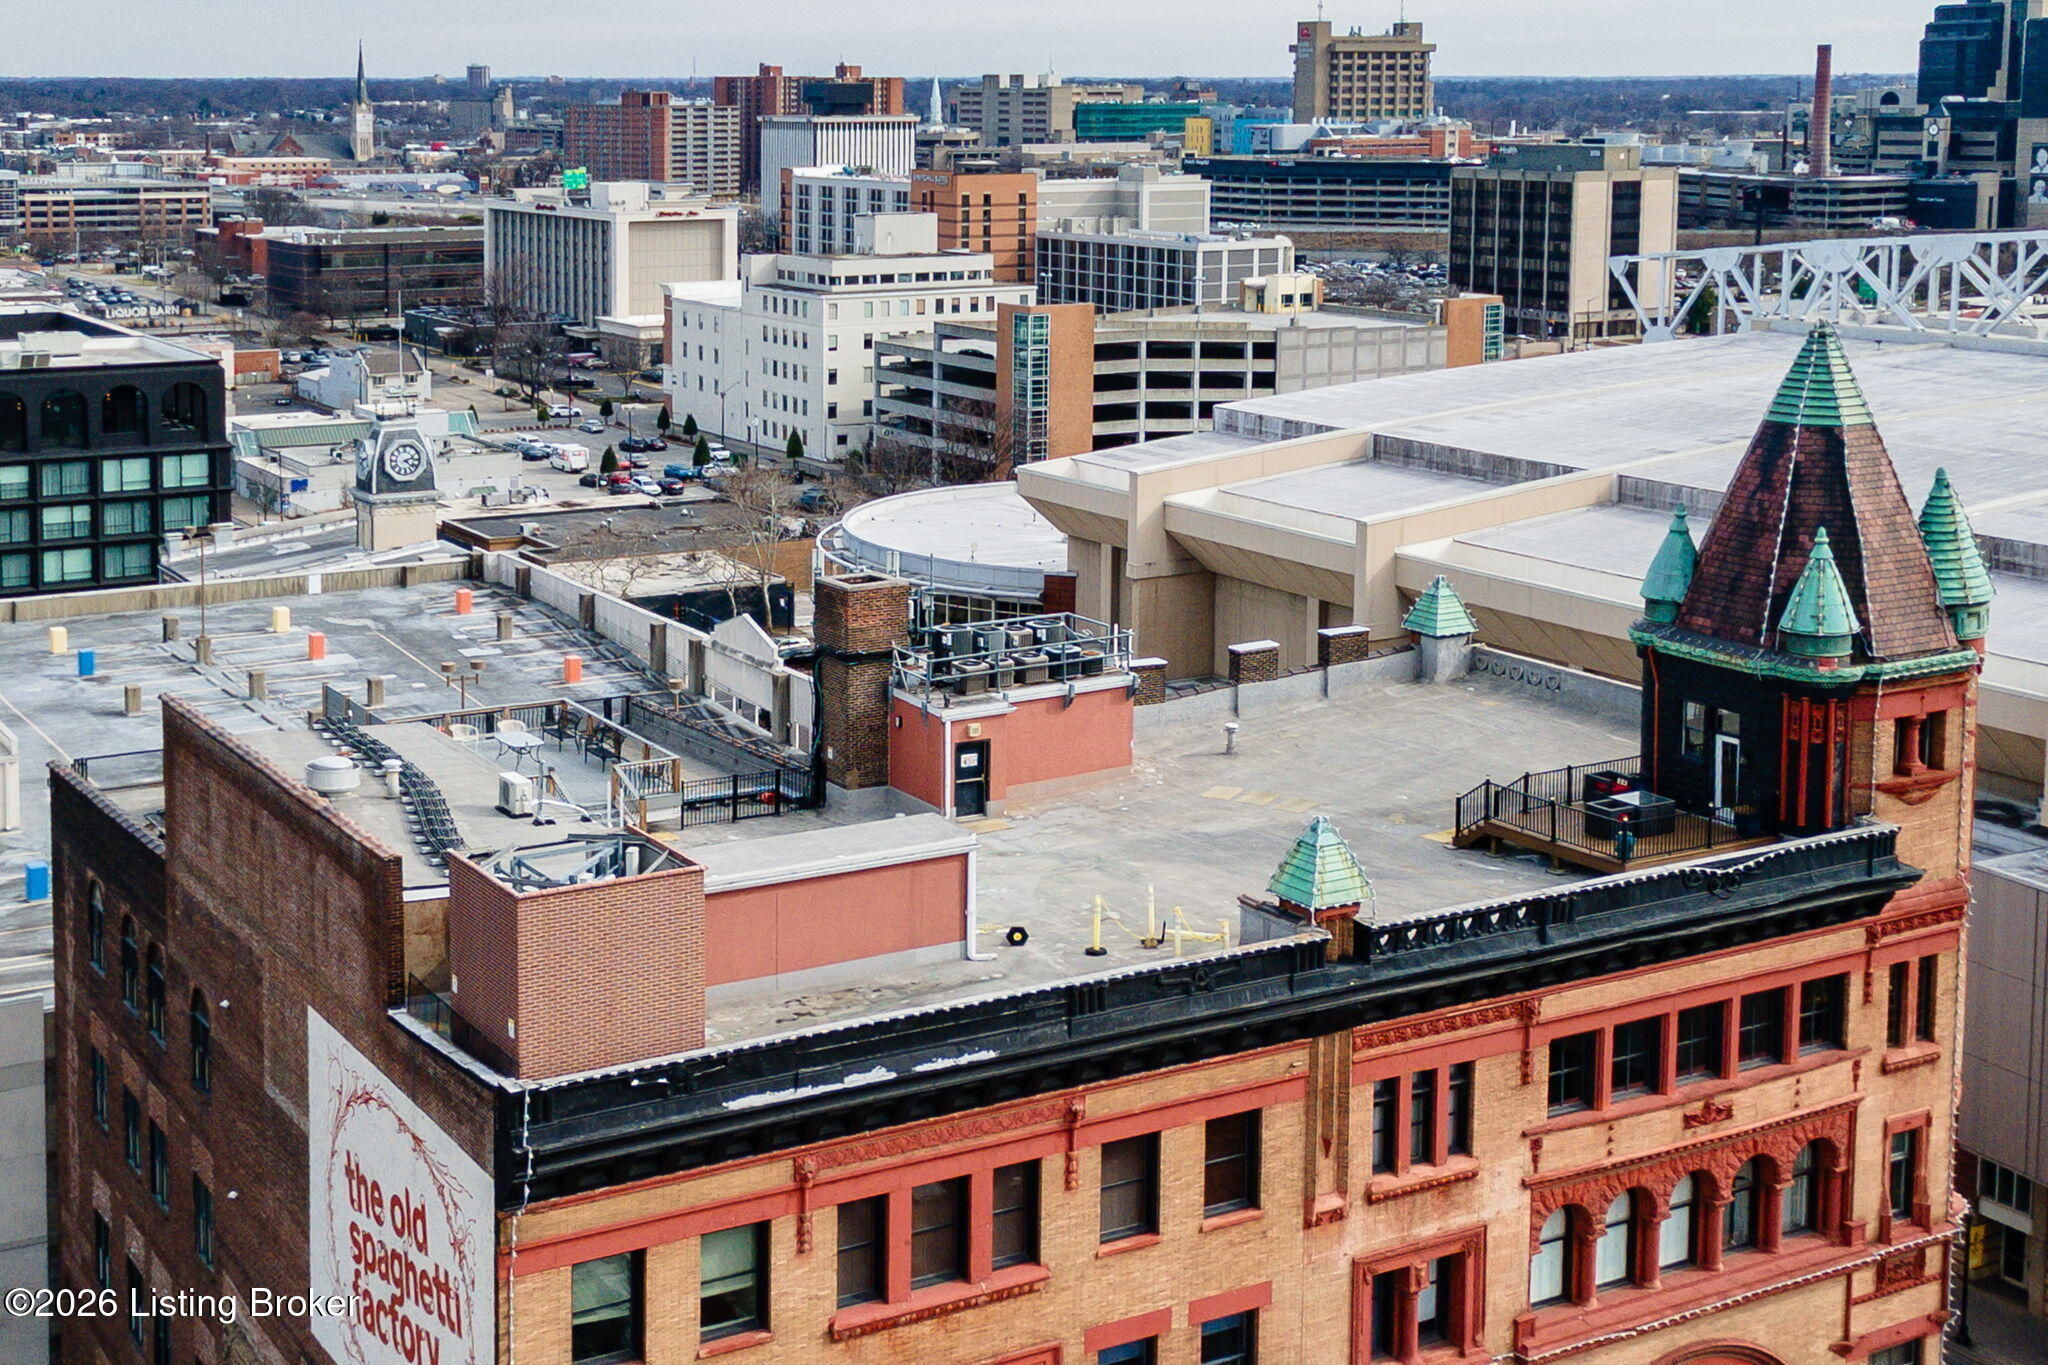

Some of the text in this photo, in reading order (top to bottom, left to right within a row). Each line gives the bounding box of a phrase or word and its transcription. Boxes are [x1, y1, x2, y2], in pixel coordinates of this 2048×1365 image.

[105, 304, 180, 319] LIQUOR BARN
[345, 1150, 428, 1257] the old
[350, 1221, 462, 1339] spaghetti
